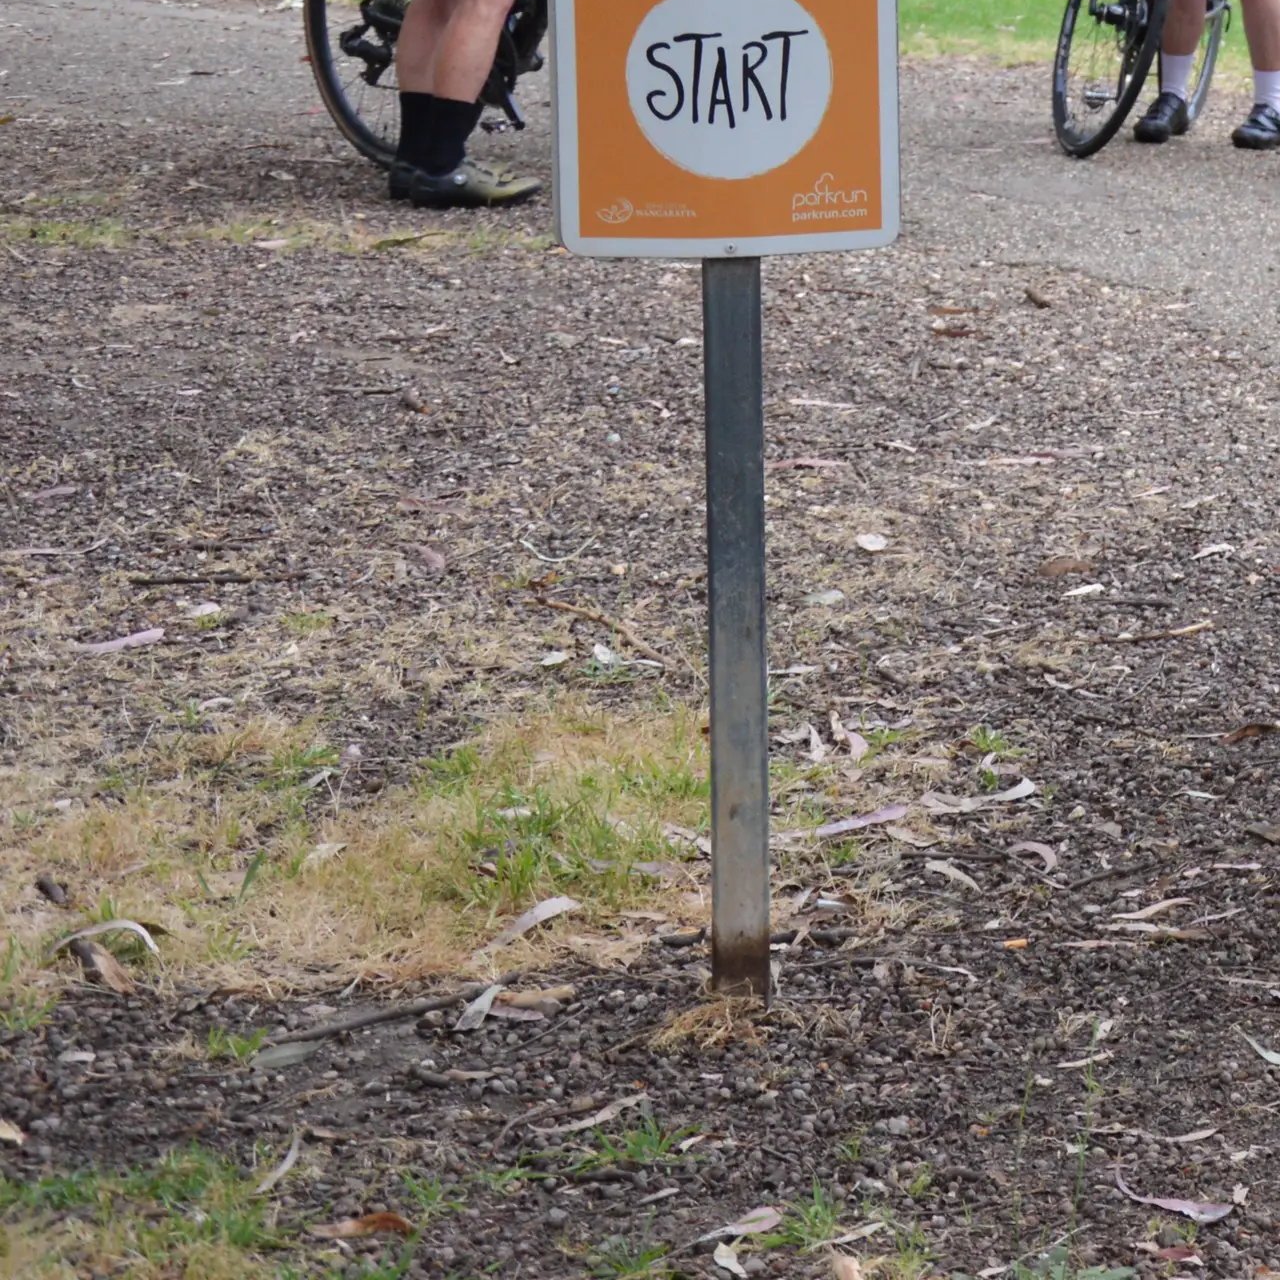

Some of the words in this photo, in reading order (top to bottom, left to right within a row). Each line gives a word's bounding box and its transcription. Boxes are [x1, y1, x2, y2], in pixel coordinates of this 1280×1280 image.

[646, 29, 809, 129] START
[792, 174, 868, 211] parkrun
[635, 209, 698, 218] WANGARATTA
[792, 208, 868, 222] parkrun.com
